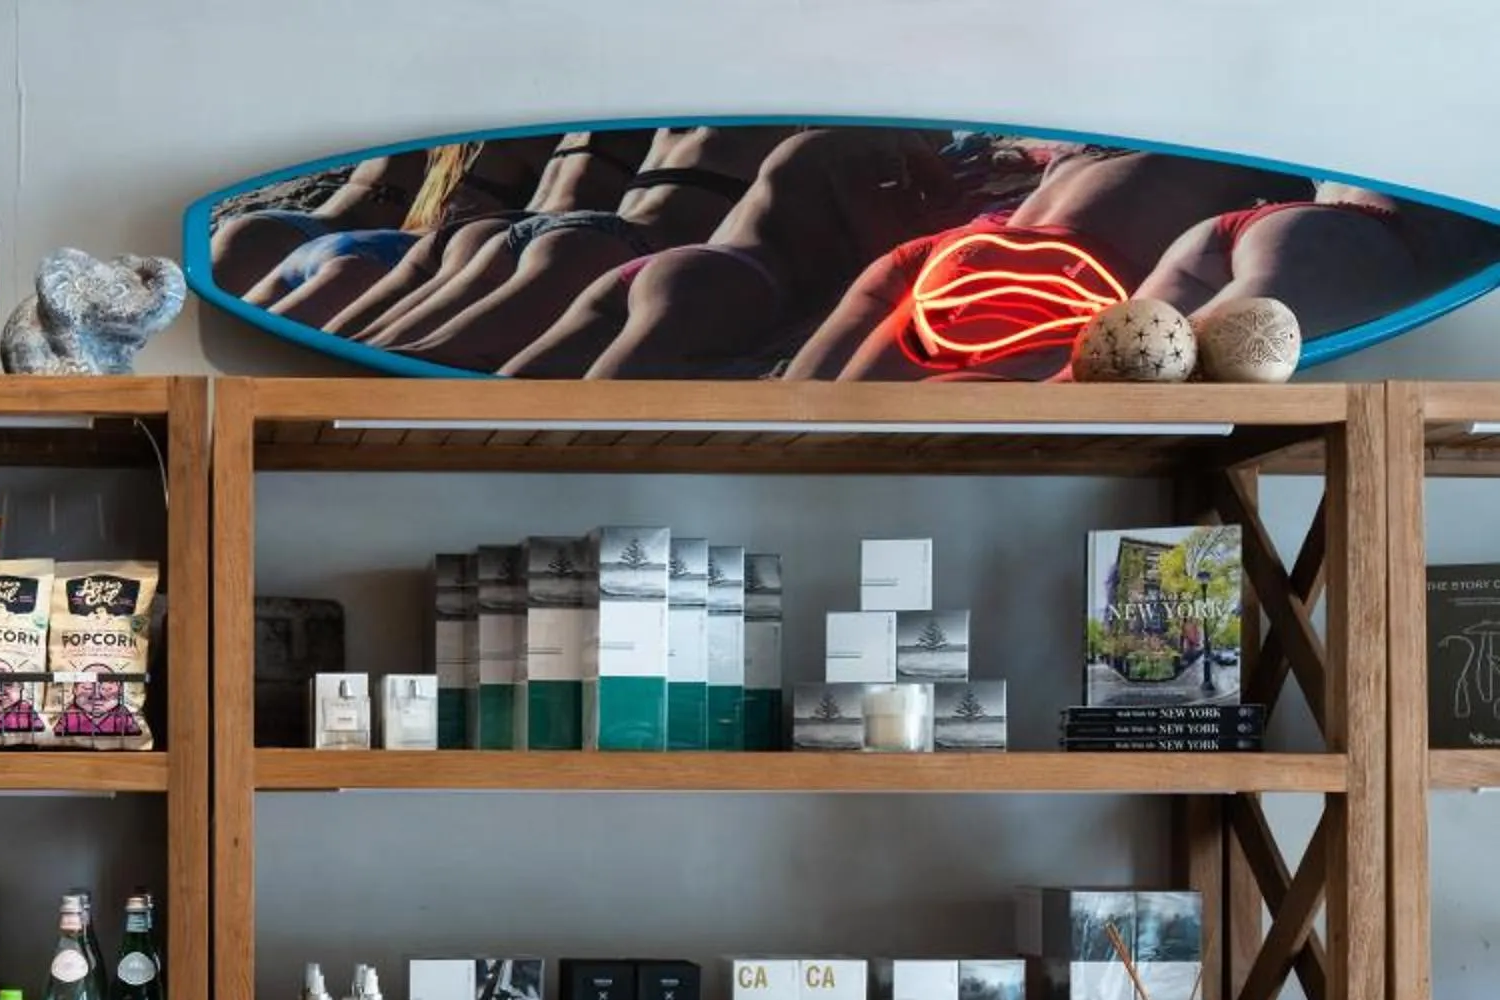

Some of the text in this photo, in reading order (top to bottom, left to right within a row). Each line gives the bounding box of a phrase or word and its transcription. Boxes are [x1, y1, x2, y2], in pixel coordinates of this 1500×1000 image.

[1451, 580, 1490, 591] STORY
[1108, 600, 1224, 623] NEW YORK
[62, 633, 137, 648] POPCORN
[1159, 708, 1186, 719] NEW
[1188, 708, 1221, 719] YORK
[1159, 723, 1185, 734] NEW
[1187, 723, 1220, 734] YORK
[1159, 740, 1185, 750] NEW
[1187, 740, 1220, 750] YORK
[738, 965, 769, 989] CA
[805, 965, 836, 989] CA
